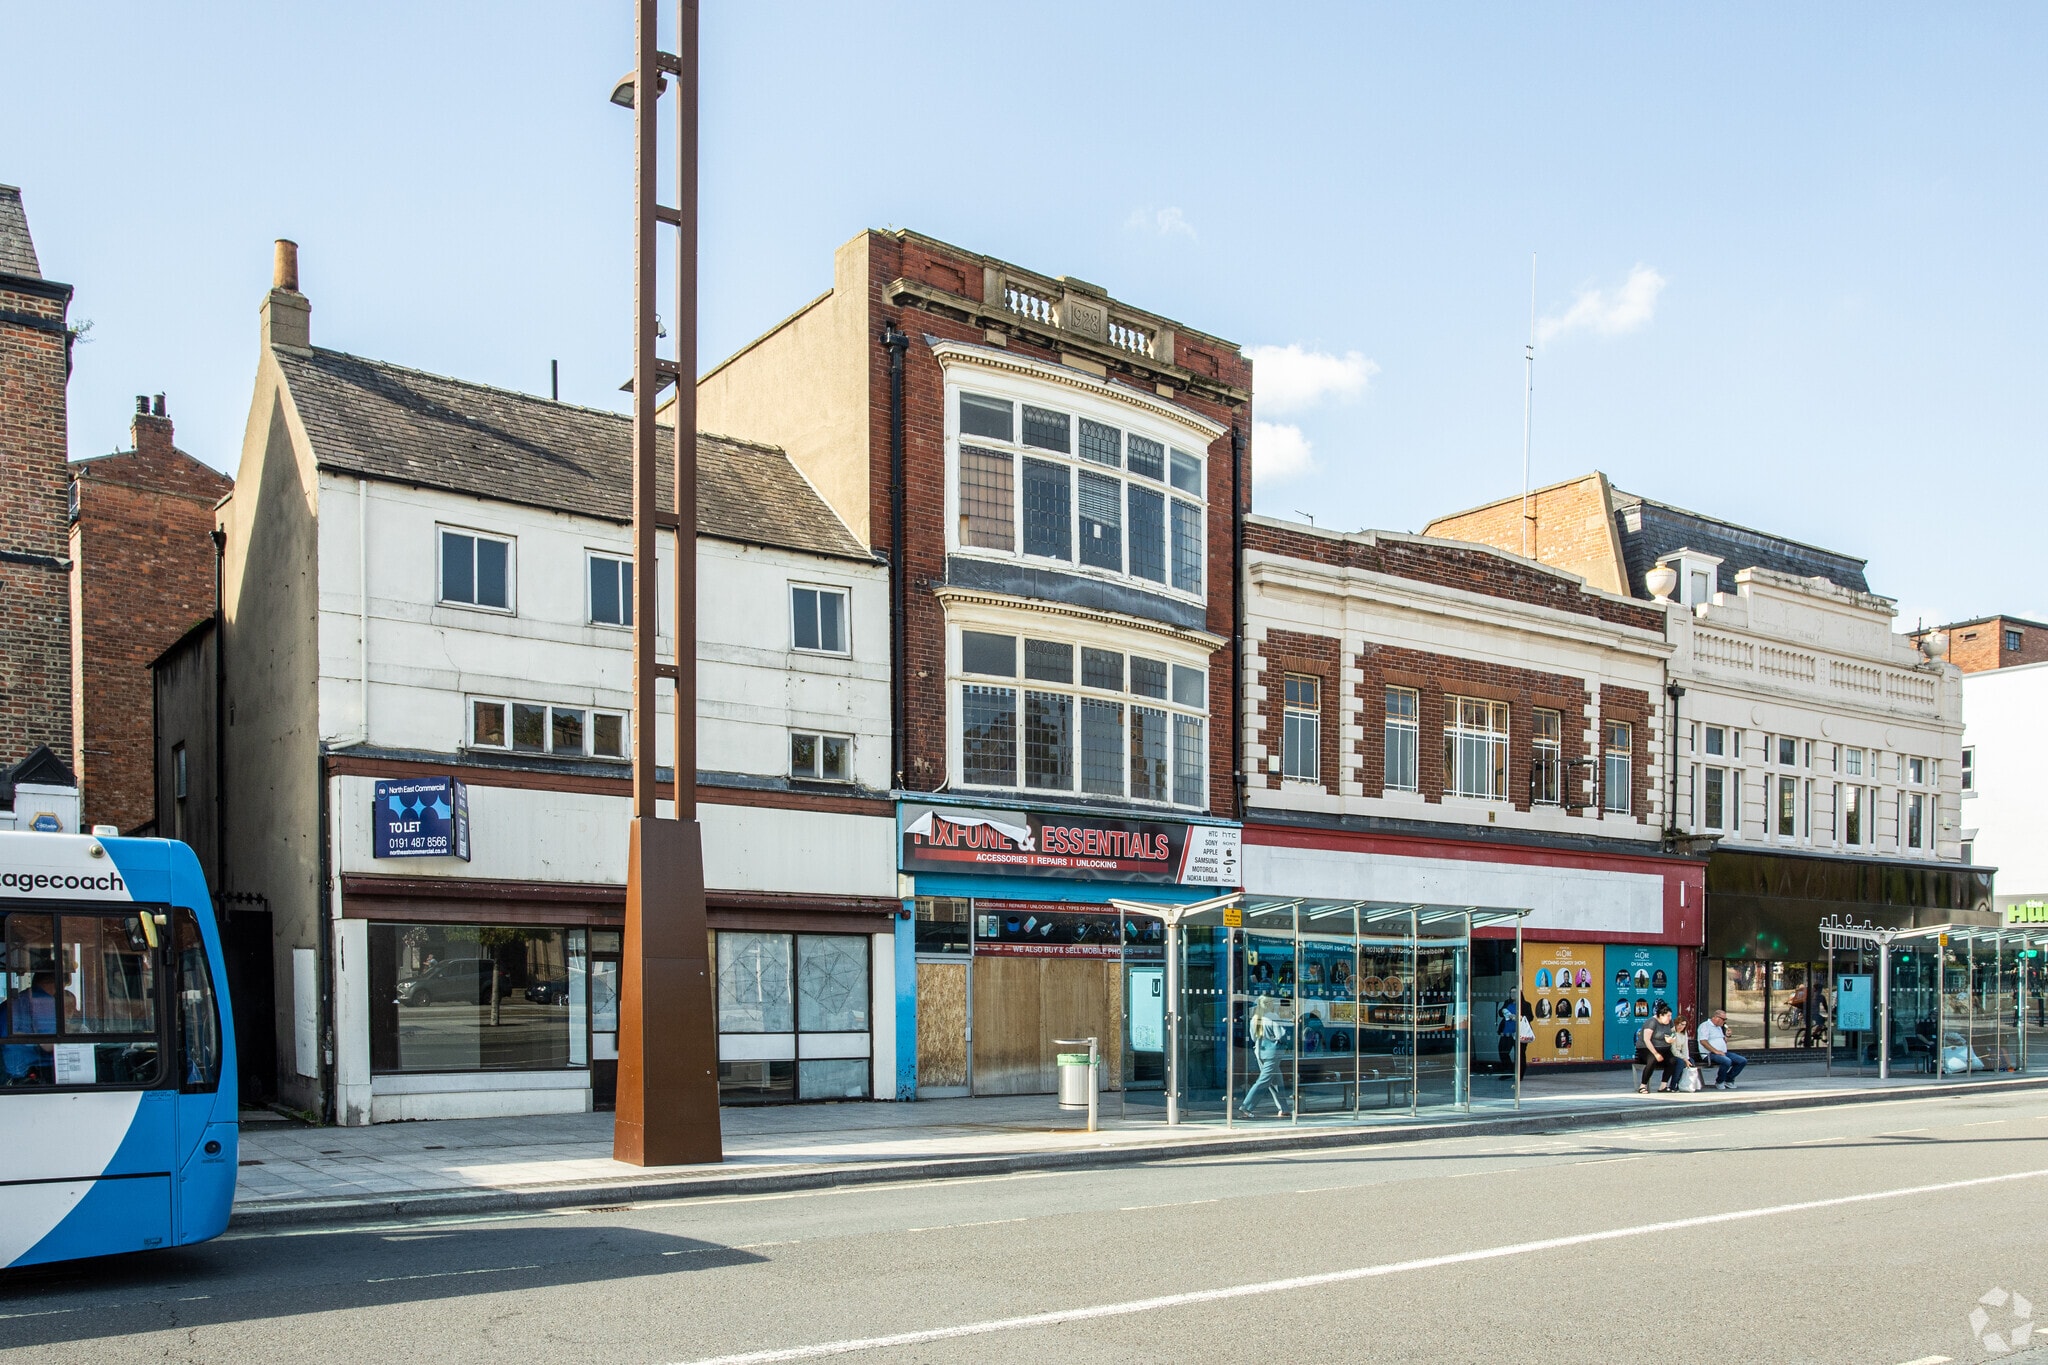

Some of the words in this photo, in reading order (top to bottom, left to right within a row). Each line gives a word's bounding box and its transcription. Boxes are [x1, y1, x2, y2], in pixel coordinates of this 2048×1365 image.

[1071, 305, 1098, 334] 1928
[389, 786, 404, 794] North
[404, 785, 414, 793] East
[415, 783, 446, 794] Commercial
[389, 822, 403, 833] TO
[404, 822, 421, 833] LET
[389, 838, 408, 849] 0191
[411, 837, 425, 848] 487
[427, 836, 447, 847] 8566
[1018, 824, 1036, 851] &
[1042, 826, 1169, 860] ESSENTIALS
[389, 848, 447, 856] northeastcommercial.co.uk
[976, 853, 1028, 864] ACCESSORIES
[1037, 857, 1068, 866] REPAIRS
[1076, 858, 1117, 869] UNLOCKING
[1194, 856, 1218, 865] SAMSUNG
[1192, 865, 1218, 873] MOTOROLA
[0, 872, 123, 892] agecoach
[1187, 874, 1202, 882] NOKIA
[2025, 899, 2044, 908] the
[1819, 913, 1913, 952] thirtn
[1013, 945, 1024, 953] WE
[1044, 946, 1058, 954] BUY
[1082, 947, 1106, 955] MOBILE
[1152, 981, 1160, 994] U
[1843, 980, 1853, 990] V
